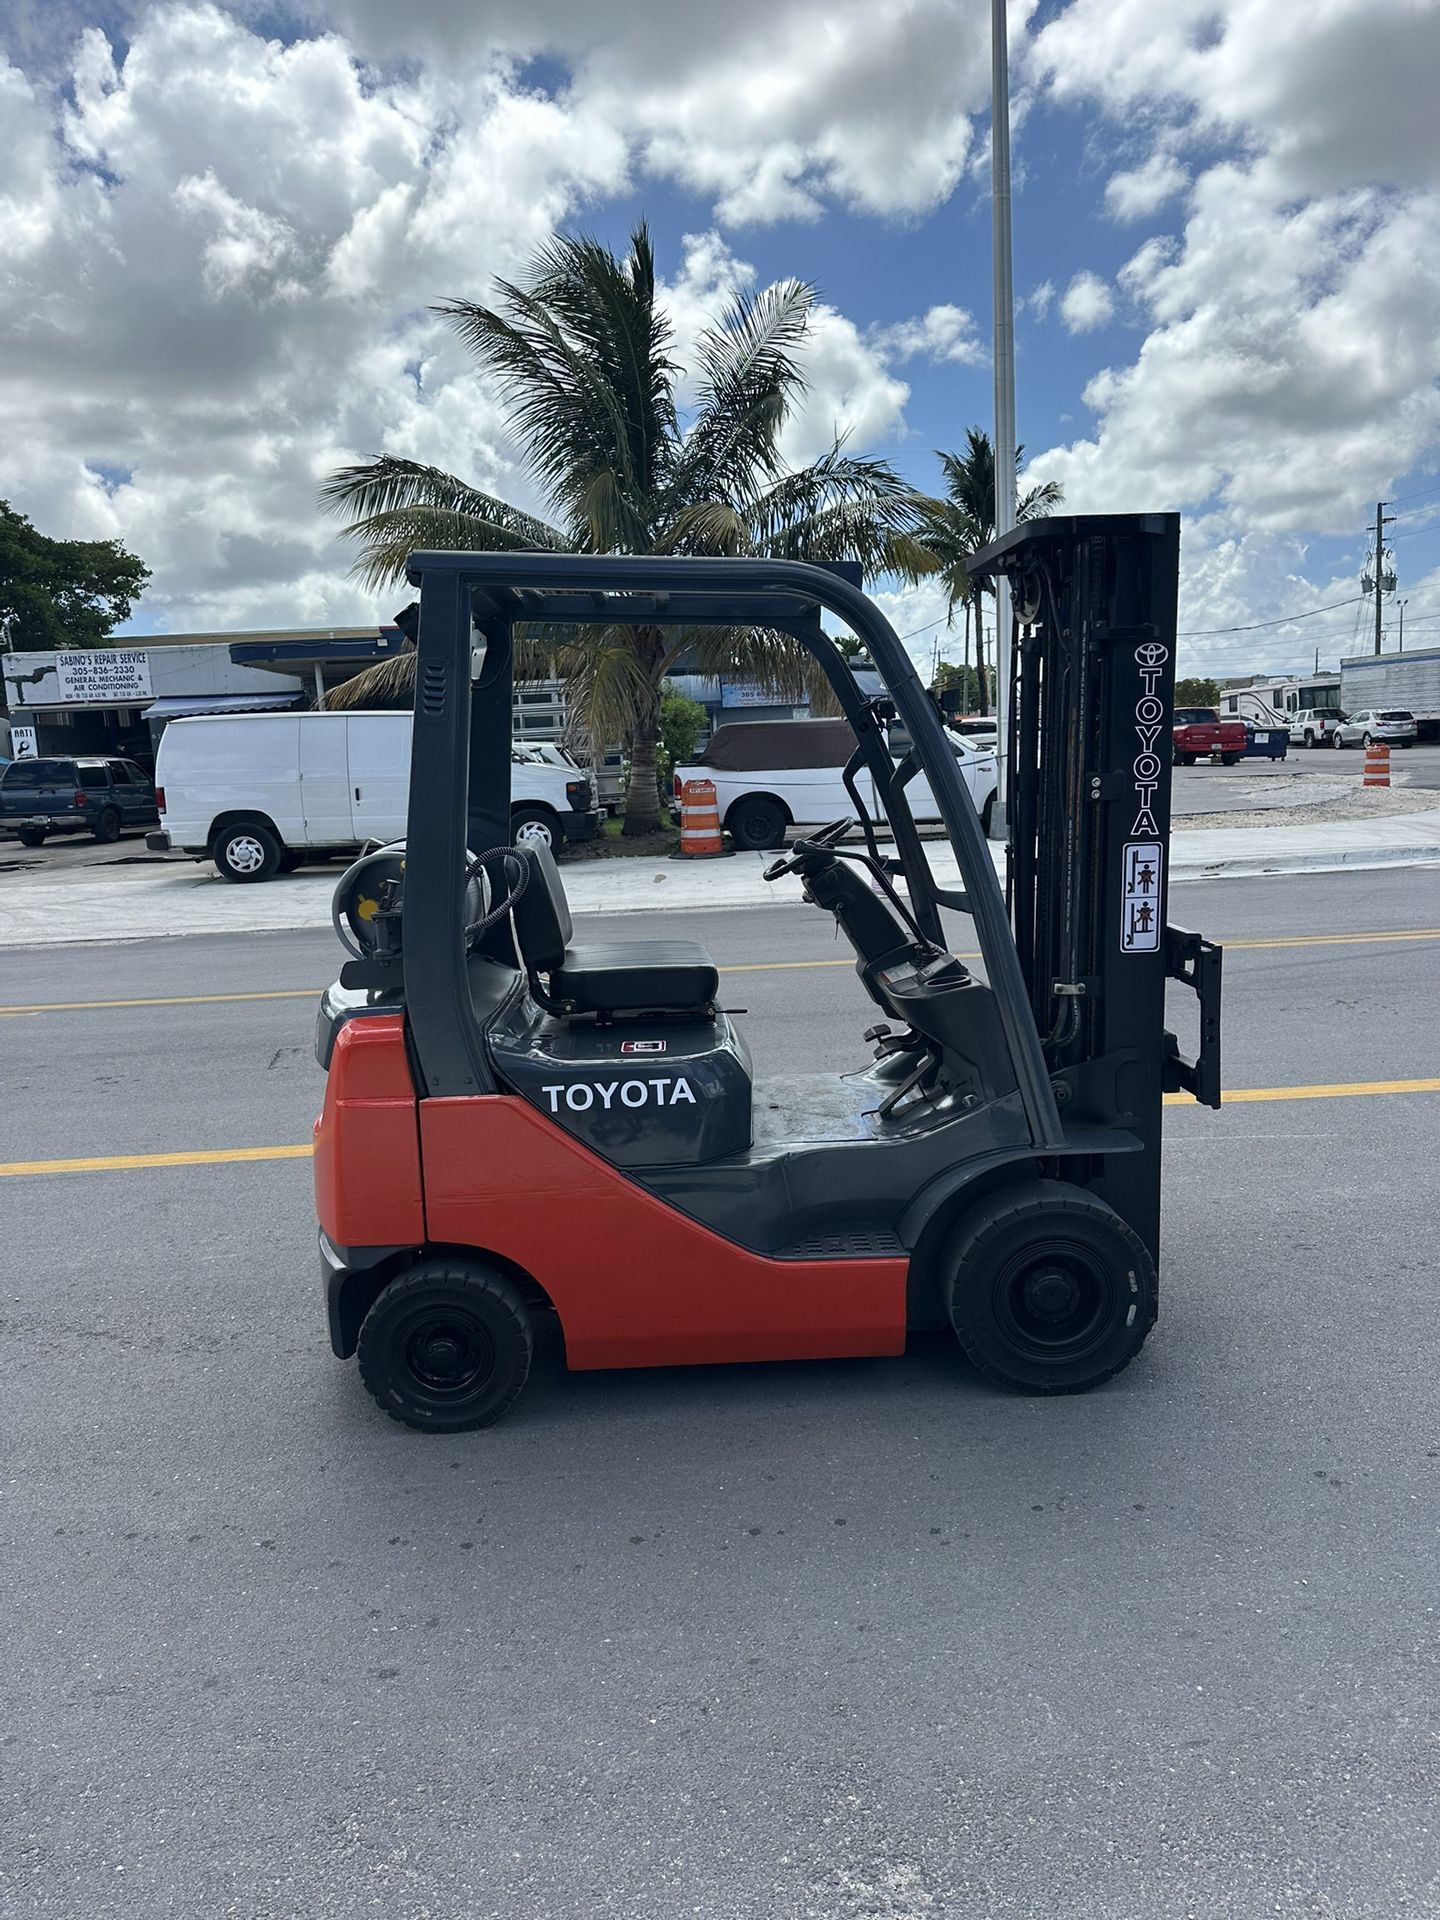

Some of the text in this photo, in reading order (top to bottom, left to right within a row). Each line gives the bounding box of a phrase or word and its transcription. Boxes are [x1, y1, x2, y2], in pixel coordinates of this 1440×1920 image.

[60, 652, 146, 666] SABINO'S REPAIR SERVICE
[72, 665, 135, 675] 305-836-2330
[65, 676, 97, 684] GENERAL
[98, 674, 135, 682] MECHANIC
[88, 682, 139, 691] CONDITIONING
[1130, 668, 1163, 835] TOYOTA
[542, 1077, 697, 1113] TOYOTA
